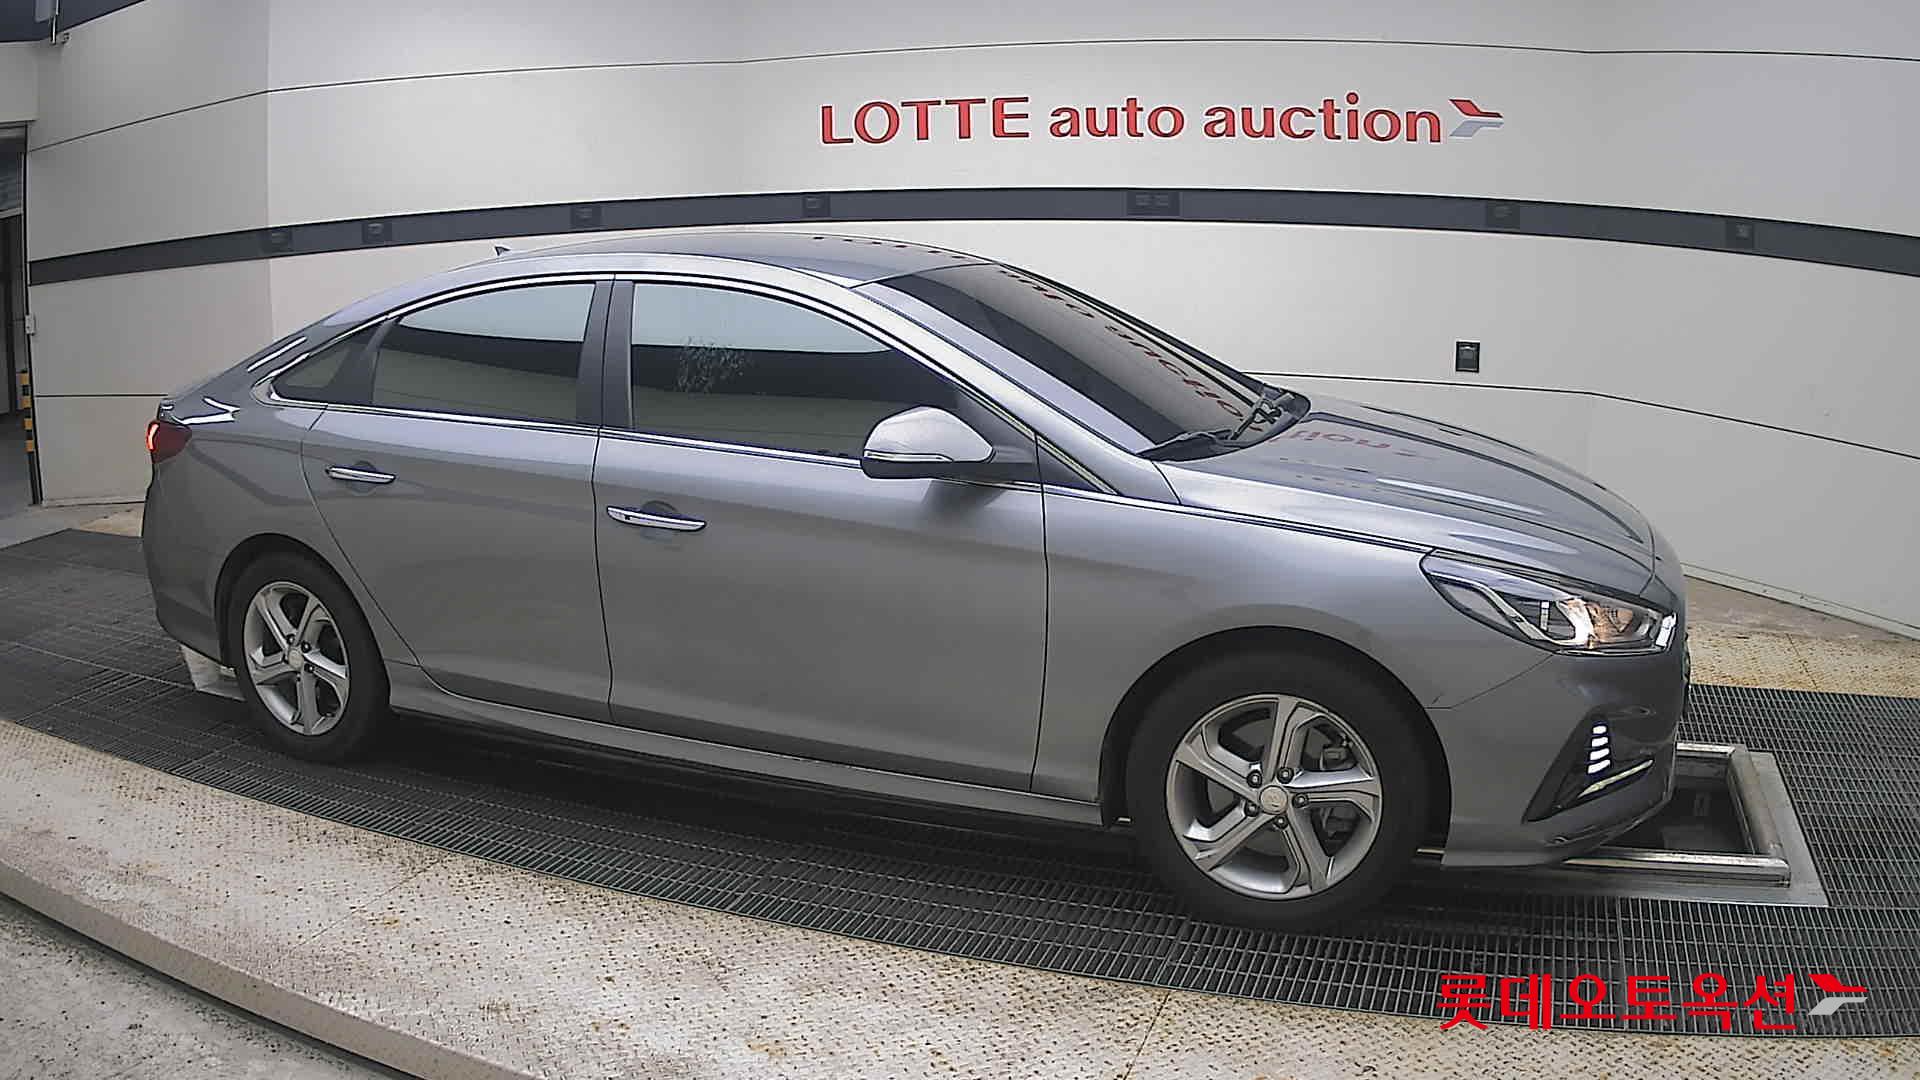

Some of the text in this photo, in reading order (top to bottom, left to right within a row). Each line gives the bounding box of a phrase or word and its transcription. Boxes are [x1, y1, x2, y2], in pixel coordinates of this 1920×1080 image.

[820, 92, 1442, 145] LOTTE auto auction
